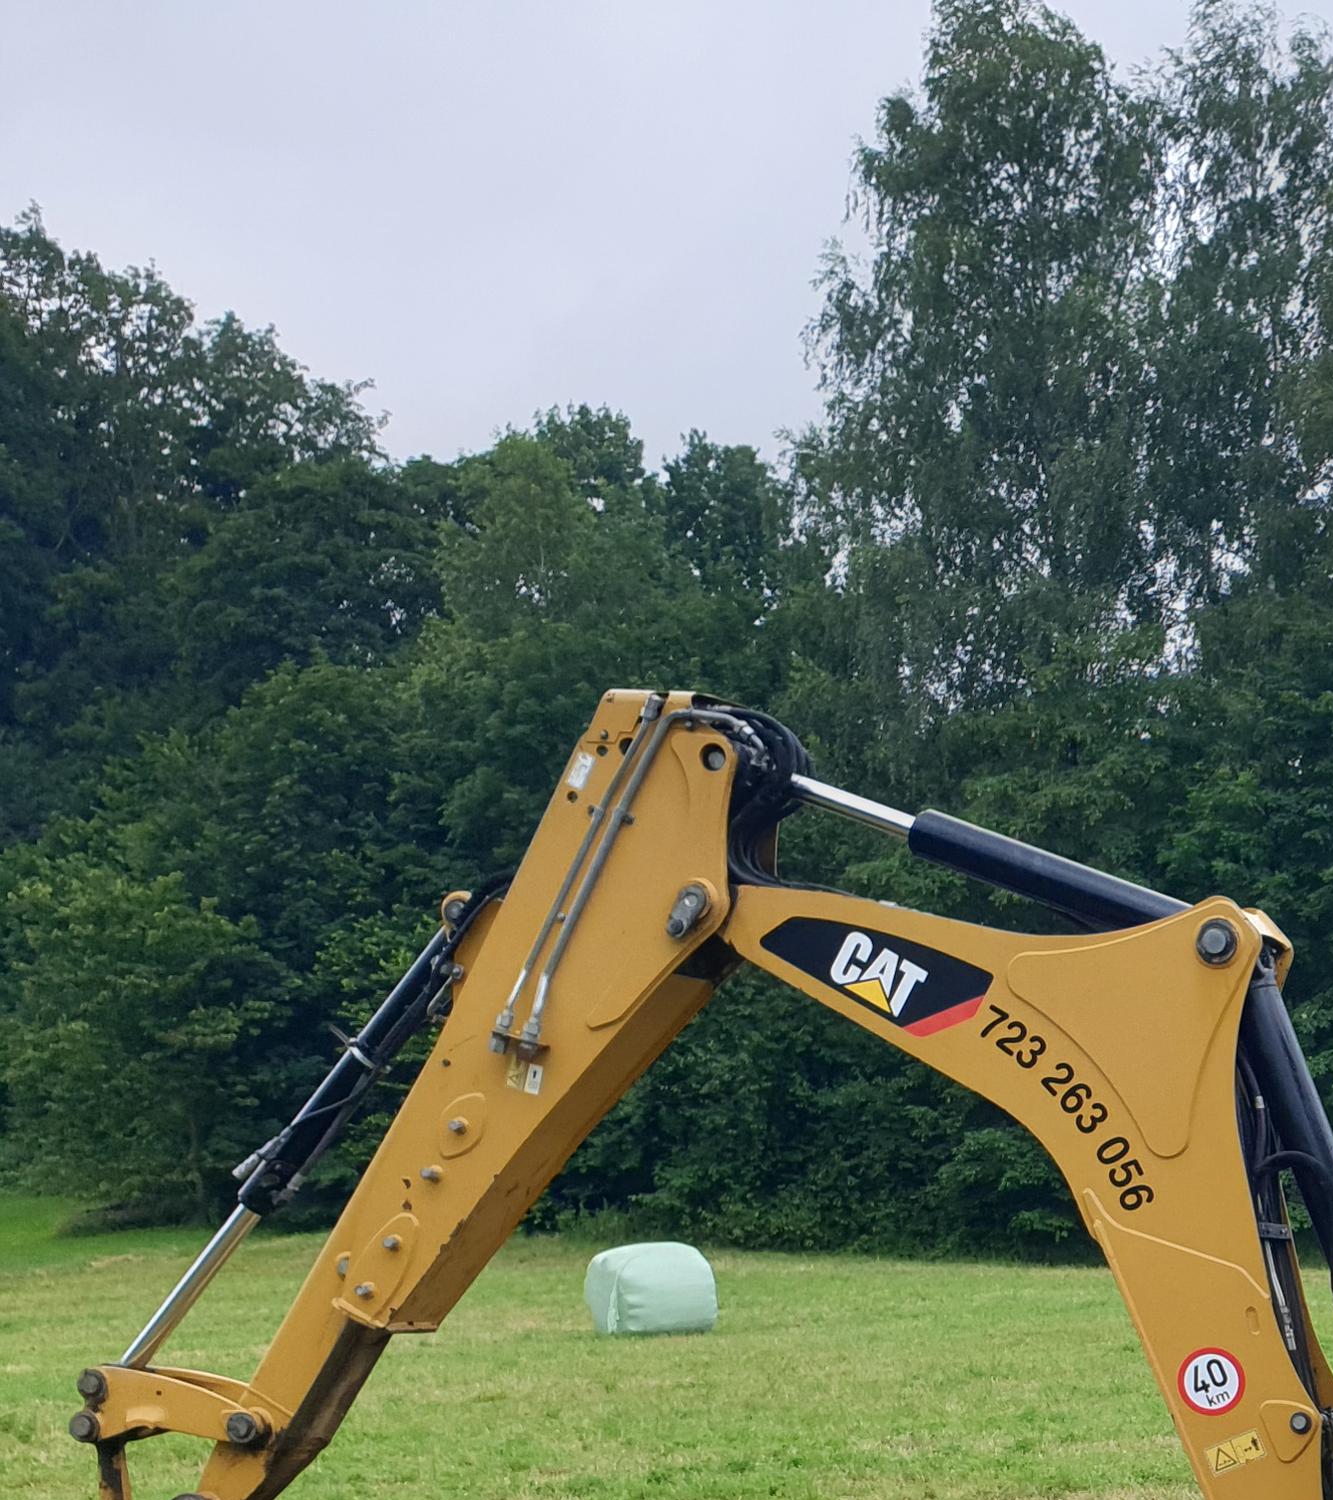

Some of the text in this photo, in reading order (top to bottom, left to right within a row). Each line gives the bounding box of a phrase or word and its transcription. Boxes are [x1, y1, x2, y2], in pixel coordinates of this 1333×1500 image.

[830, 930, 929, 1018] CAT
[980, 1004, 1155, 1211] 723 263 056
[1193, 1358, 1229, 1394] 40
[1205, 1391, 1231, 1408] km
